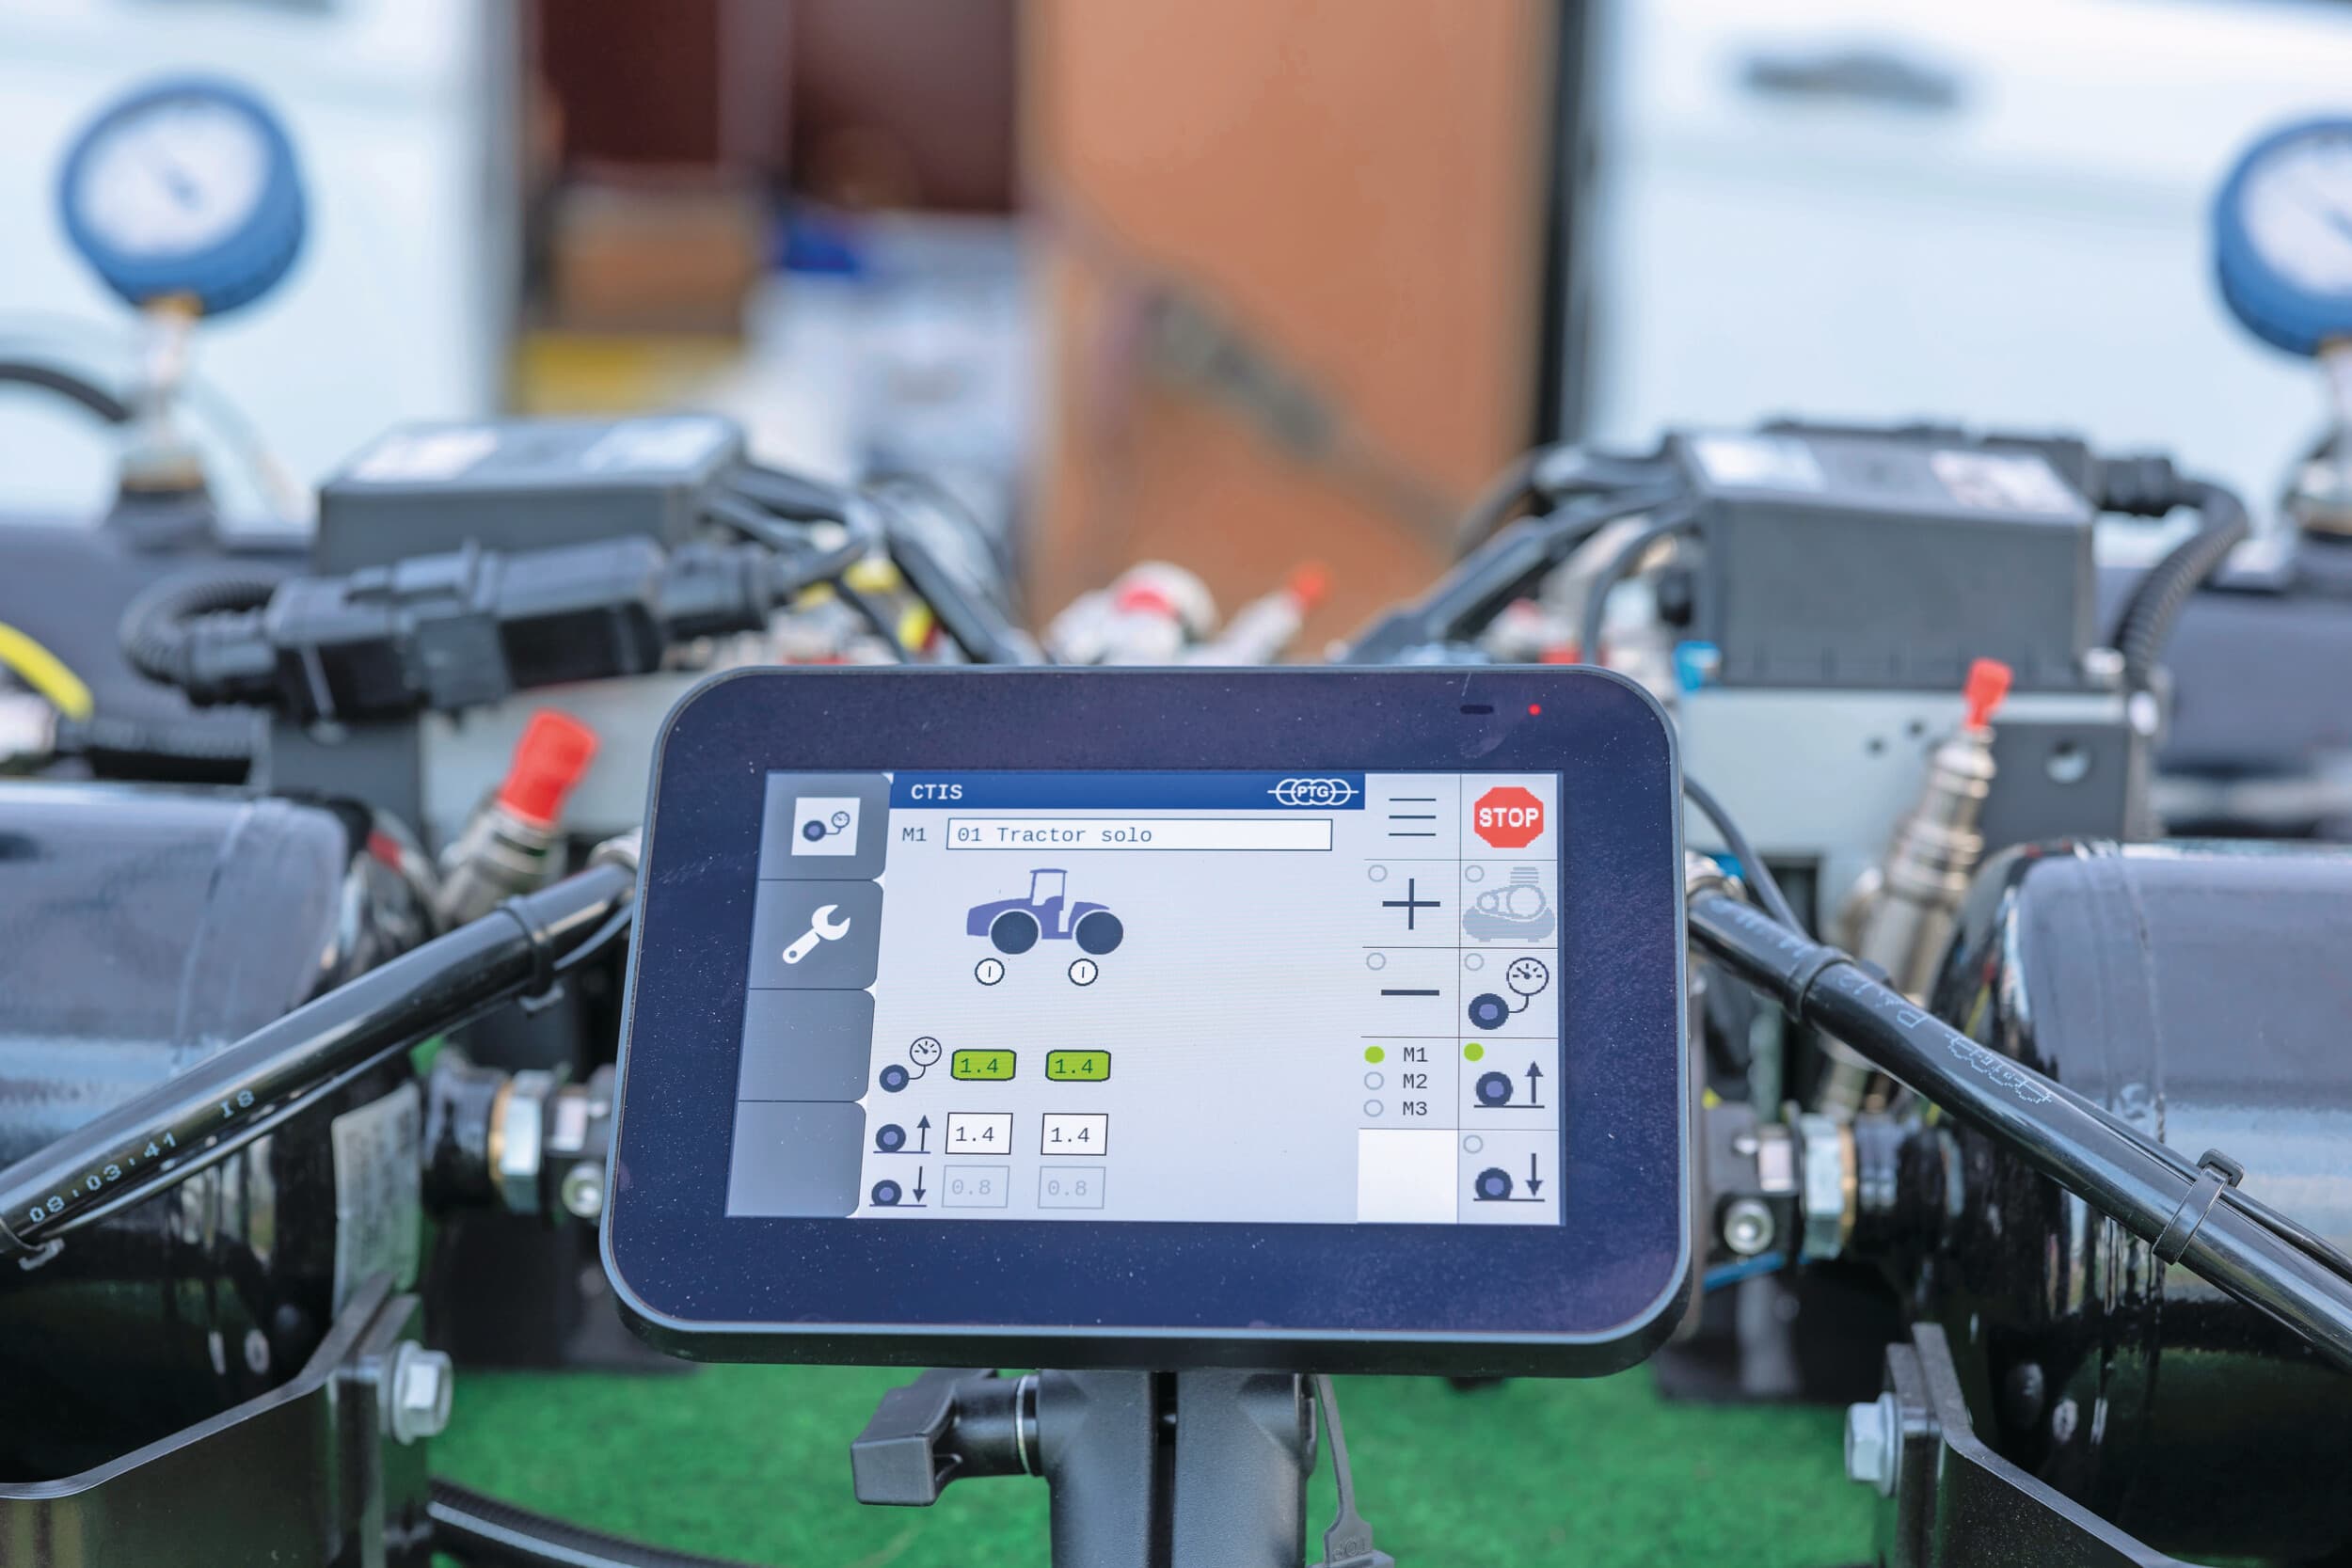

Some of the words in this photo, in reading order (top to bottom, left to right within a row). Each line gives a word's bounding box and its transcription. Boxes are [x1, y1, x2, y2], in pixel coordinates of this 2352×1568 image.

[911, 784, 963, 800] CTIS
[1296, 784, 1329, 798] PTG
[1478, 806, 1540, 829] STOP
[902, 827, 927, 842] M1
[957, 827, 982, 842] 01
[996, 827, 1087, 843] Tractor
[1102, 826, 1152, 843] solo
[1403, 1046, 1428, 1063] M1
[960, 1058, 999, 1073] 1.4
[1055, 1058, 1094, 1074] 1.4
[1403, 1073, 1428, 1089] M2
[1402, 1101, 1428, 1117] M3
[955, 1126, 994, 1142] 1.4
[1051, 1127, 1090, 1143] 1.4
[951, 1179, 992, 1196] 0.8
[1047, 1180, 1088, 1196] 0.8
